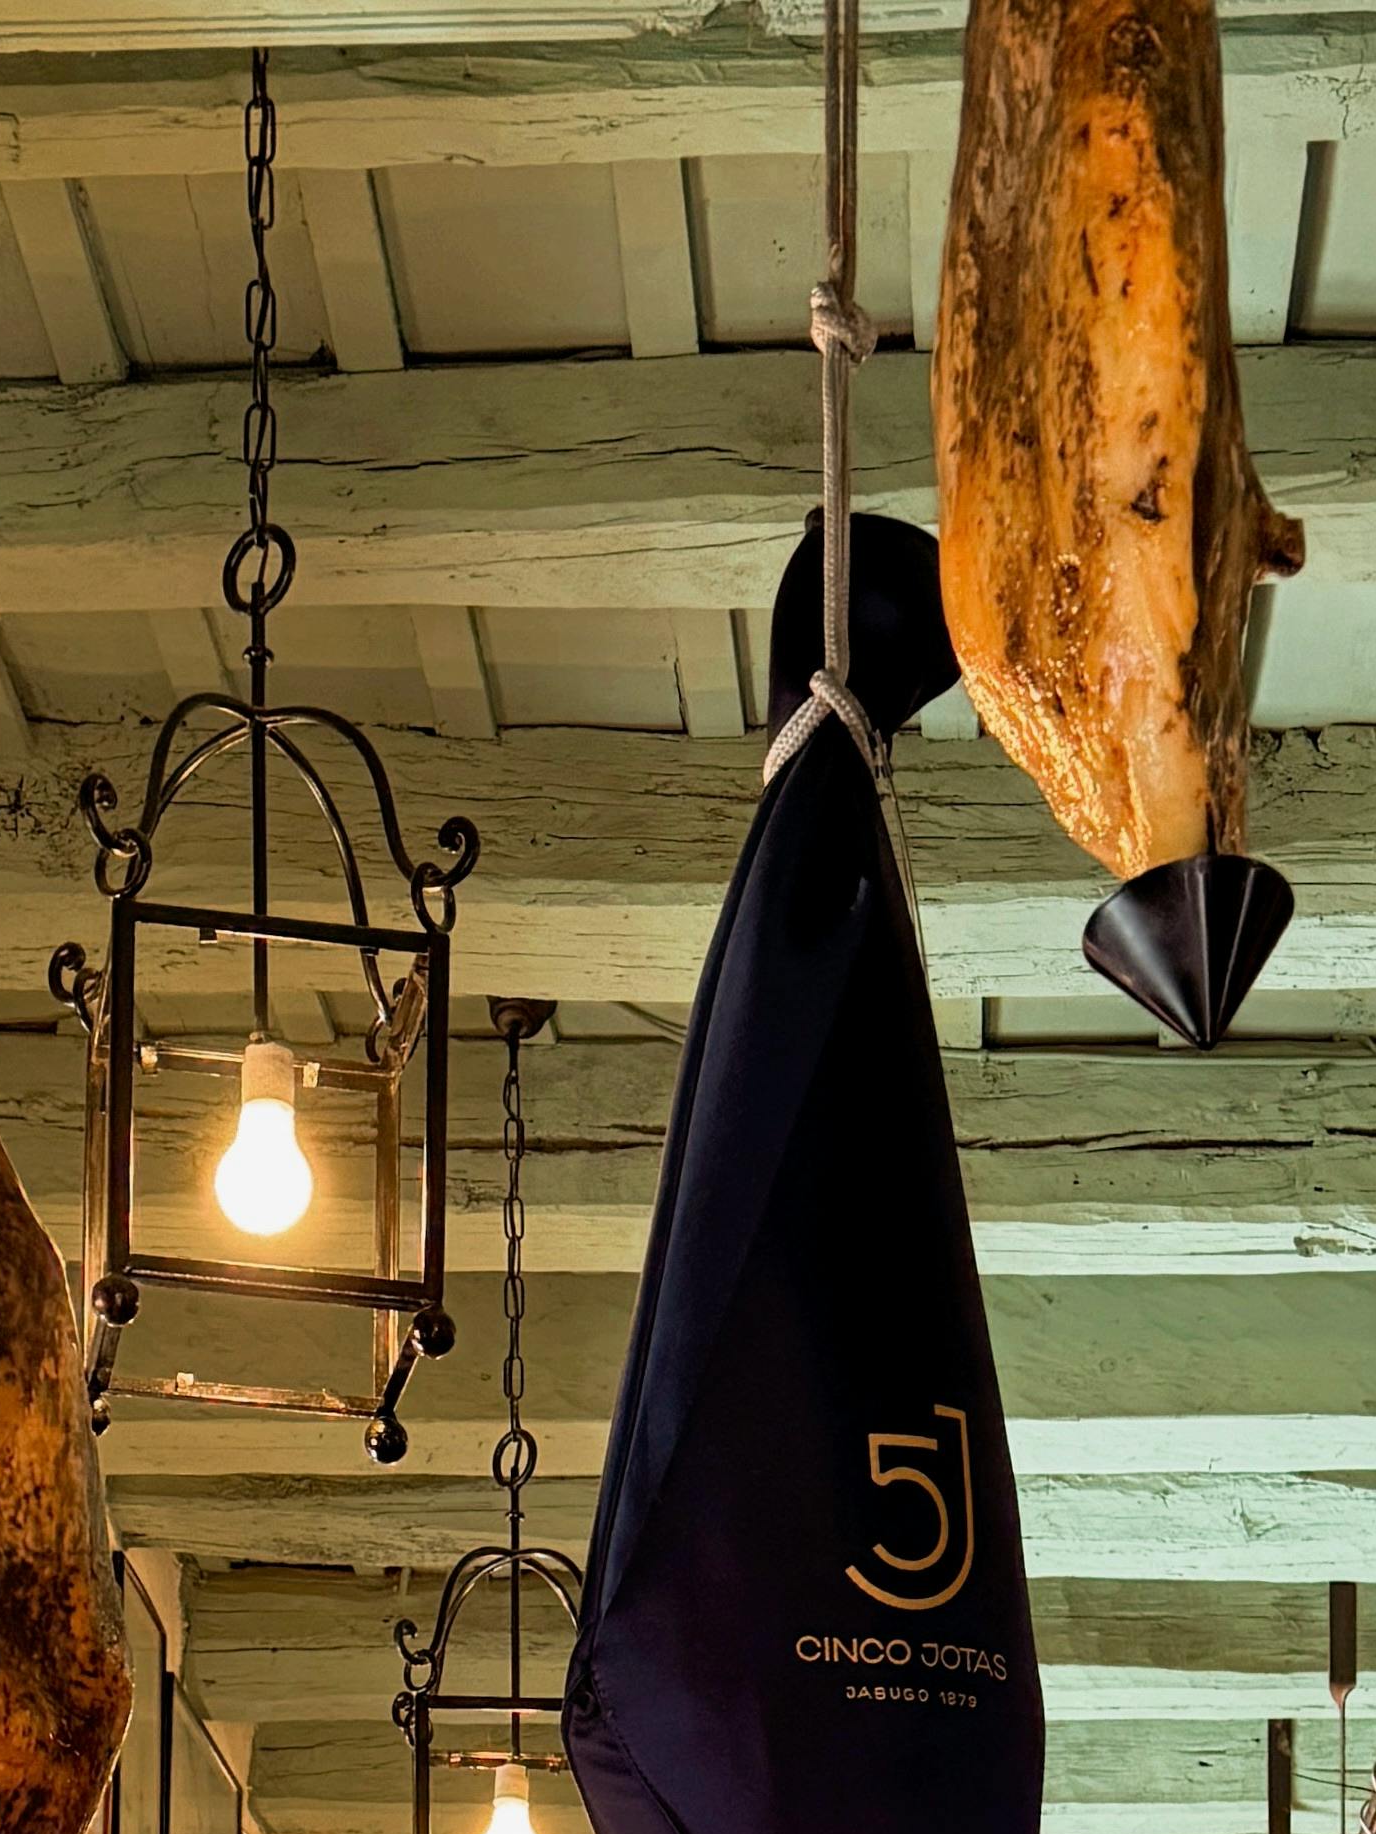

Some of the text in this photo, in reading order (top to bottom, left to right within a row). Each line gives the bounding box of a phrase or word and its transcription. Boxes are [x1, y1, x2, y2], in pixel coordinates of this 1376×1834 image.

[845, 1404, 974, 1610] 5J
[796, 1635, 1007, 1681] CINCO JOTAS
[845, 1686, 977, 1708] JABUGO 1879
